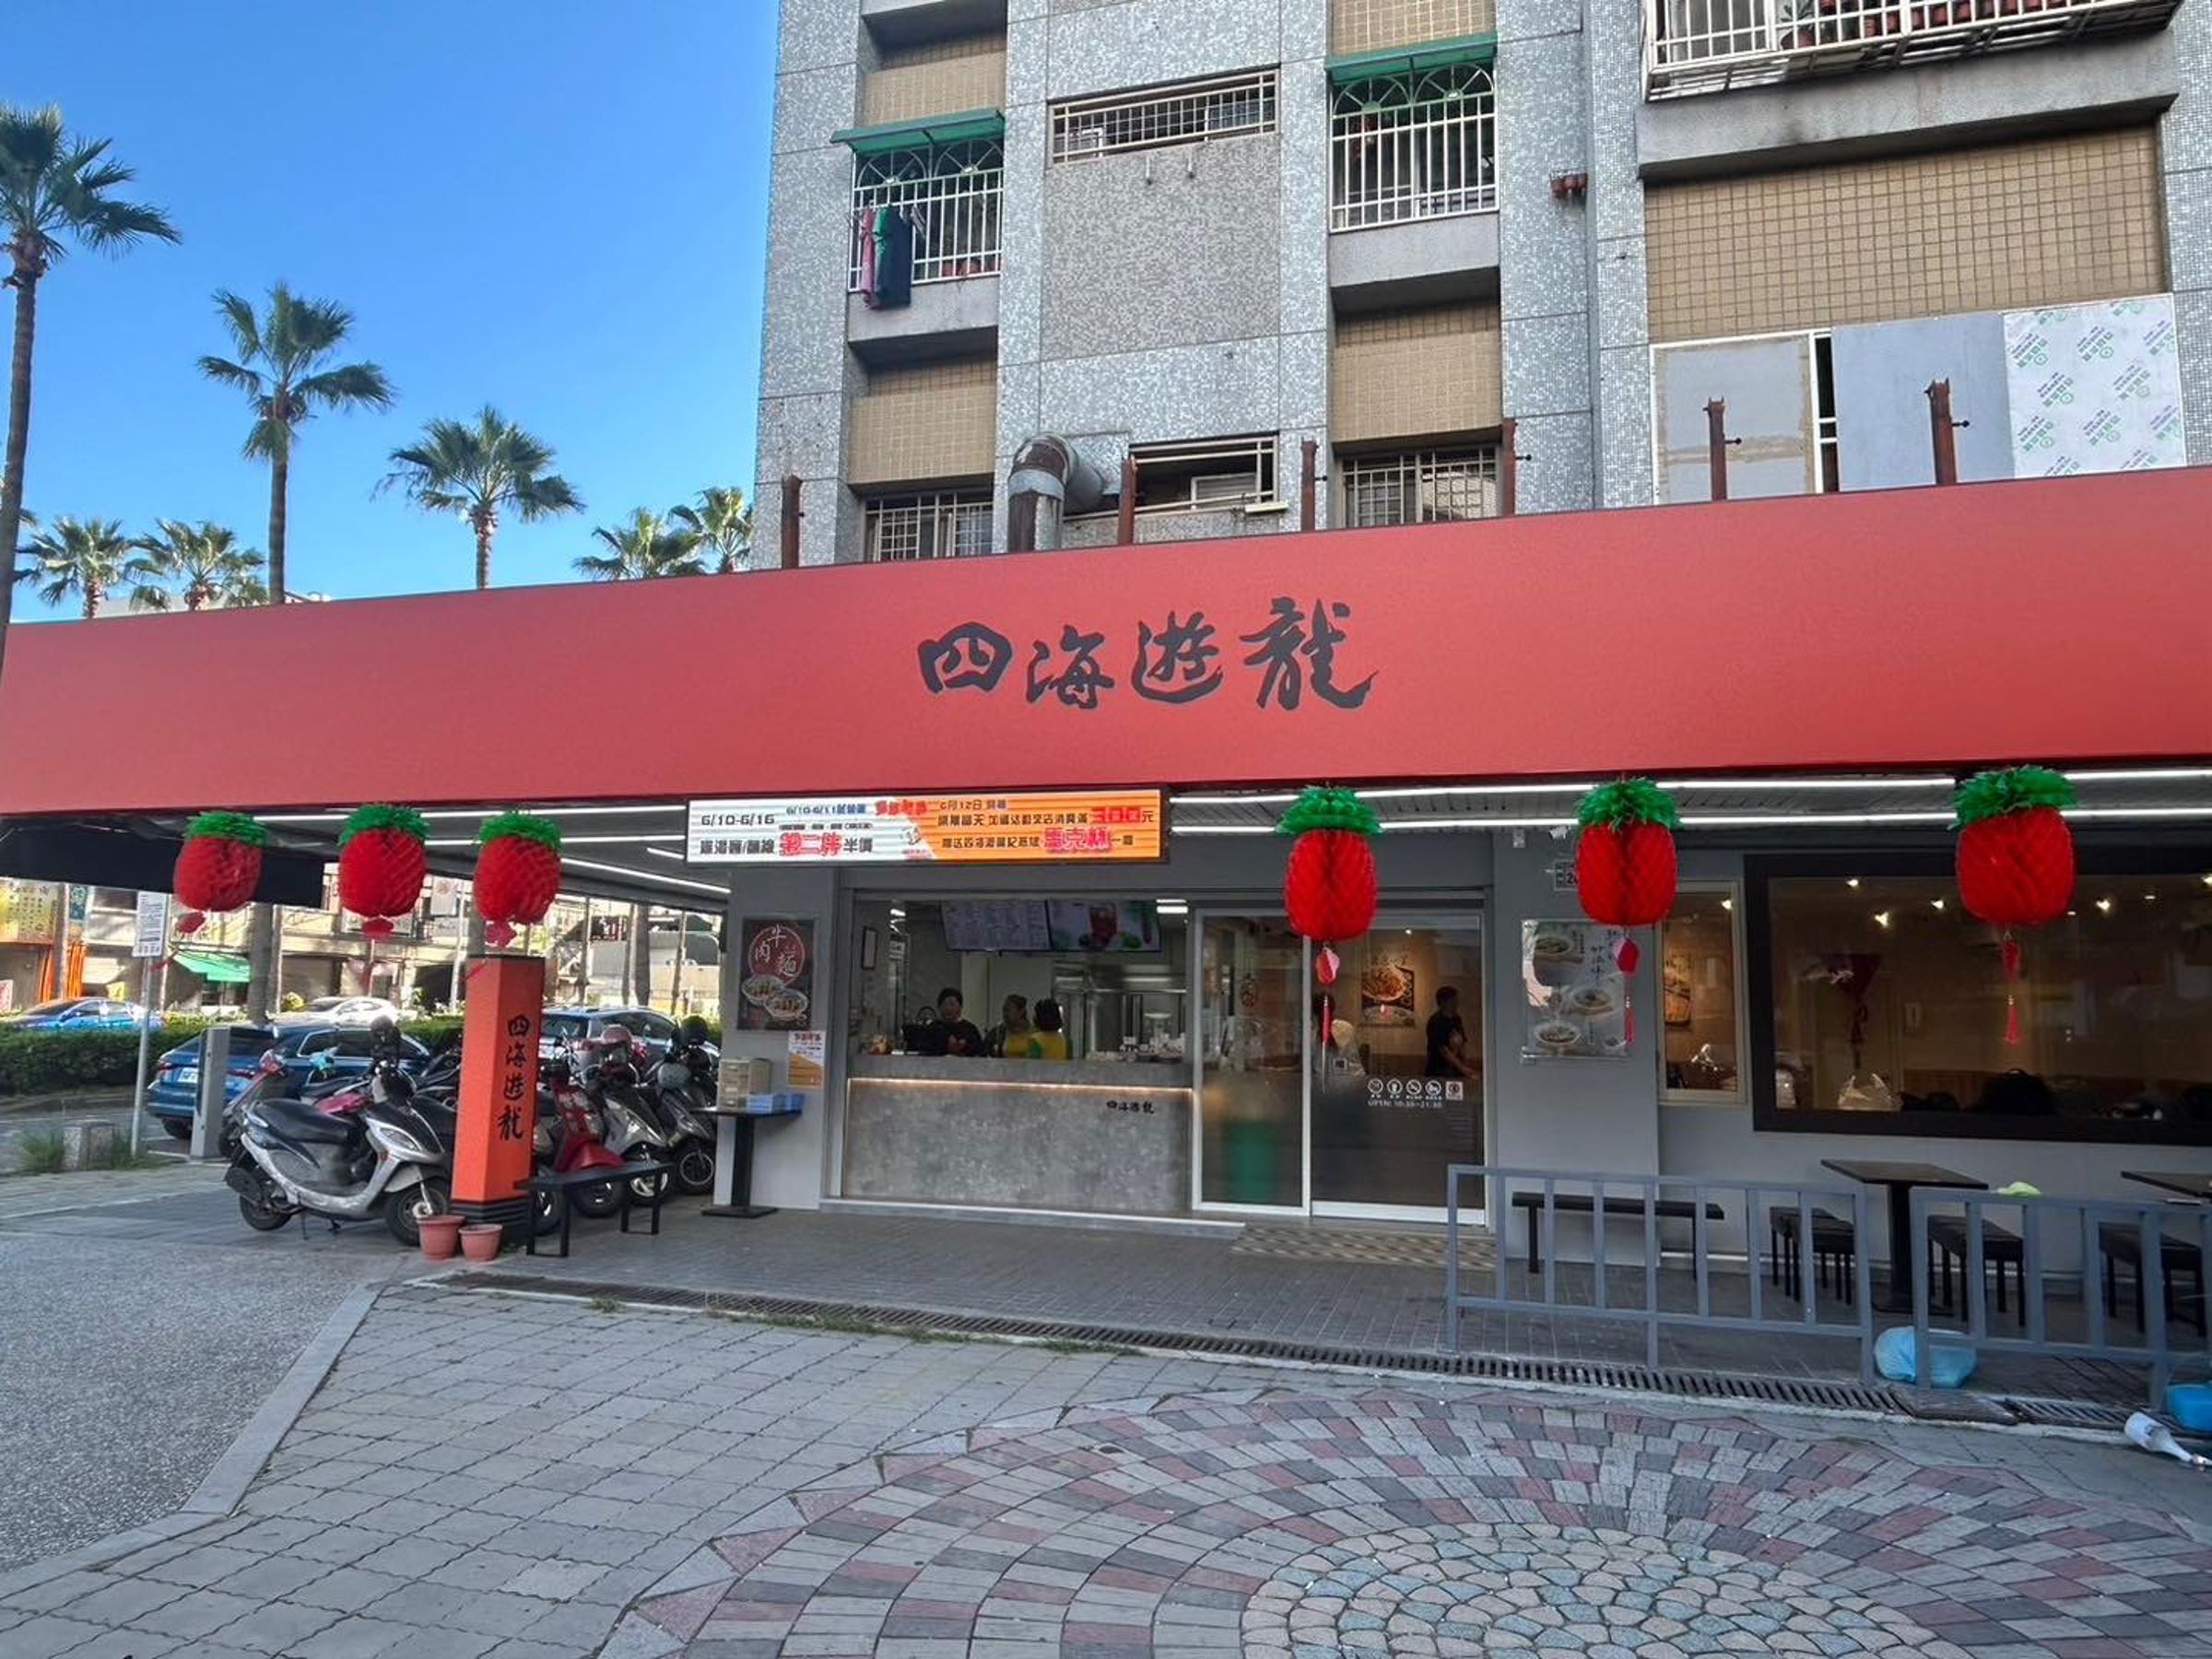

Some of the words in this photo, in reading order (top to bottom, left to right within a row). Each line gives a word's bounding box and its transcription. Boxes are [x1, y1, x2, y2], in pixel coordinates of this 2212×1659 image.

[918, 596, 1379, 711] 四海遊龍
[701, 814, 775, 826] 6/10-6/16
[498, 1015, 531, 1141] 四海遊龍
